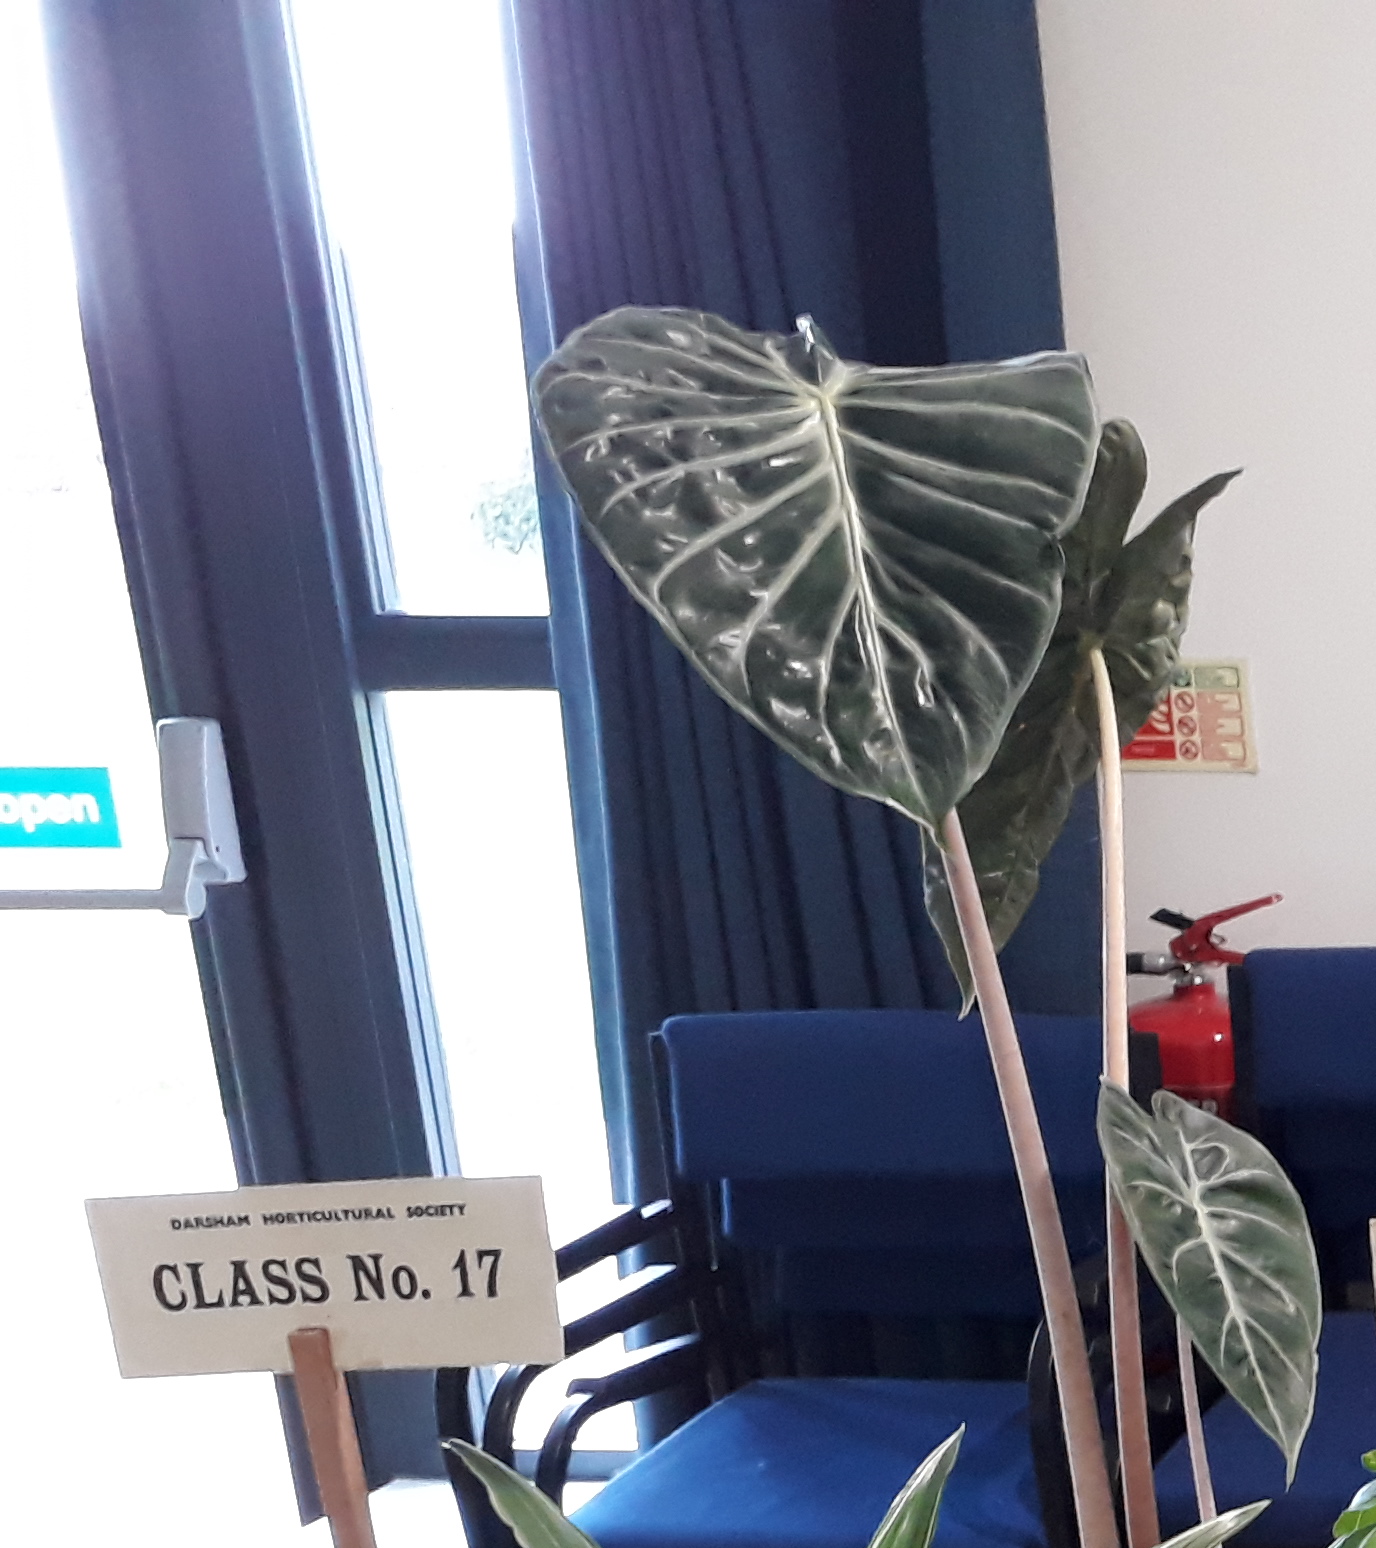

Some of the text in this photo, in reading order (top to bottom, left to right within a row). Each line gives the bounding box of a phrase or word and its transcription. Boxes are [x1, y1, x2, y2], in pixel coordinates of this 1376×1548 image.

[171, 1203, 466, 1230] DARSHAM HORTICULTURAL SOCIETY
[153, 1249, 502, 1311] CLASS No. 17
